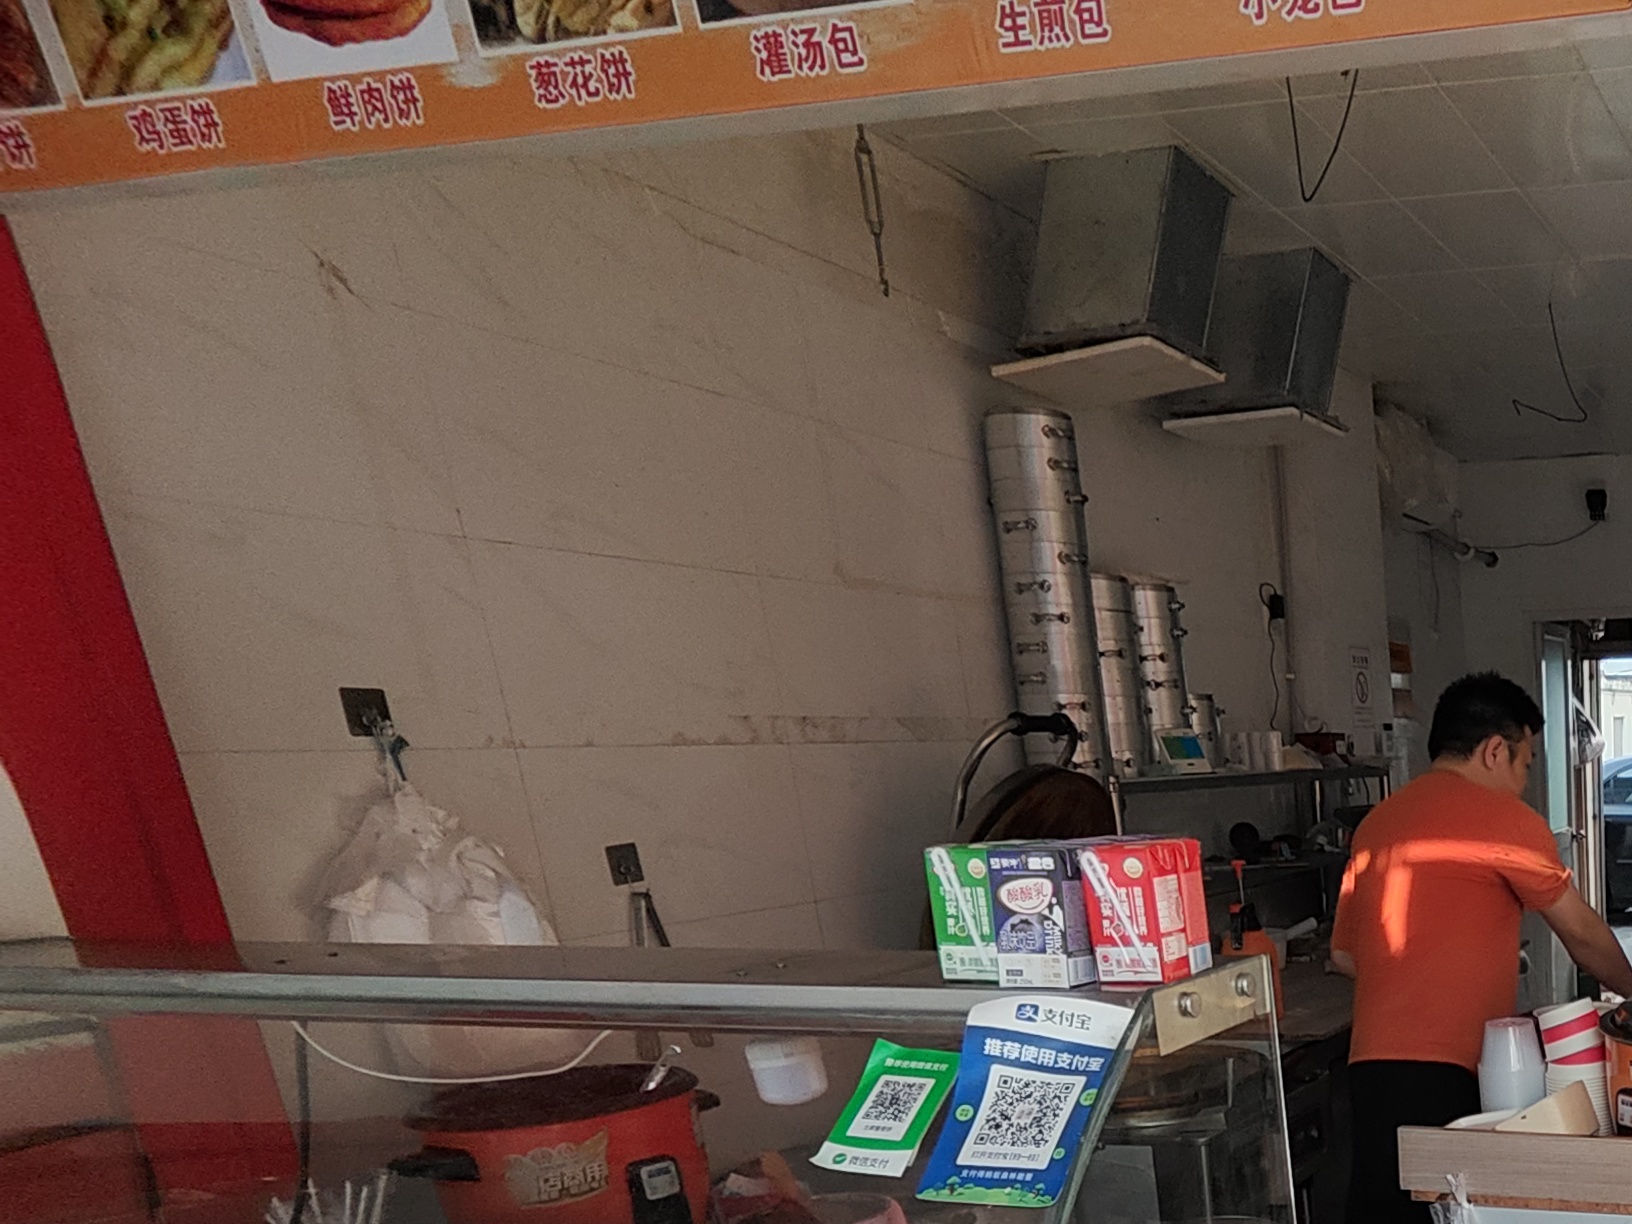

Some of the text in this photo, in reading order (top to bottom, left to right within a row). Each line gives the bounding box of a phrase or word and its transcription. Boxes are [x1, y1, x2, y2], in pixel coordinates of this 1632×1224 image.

[752, 21, 867, 80] 灌汤包
[998, 0, 1110, 51] 生煎包
[528, 46, 637, 108] 葱花饼
[127, 100, 225, 153] 鸡蛋饼
[322, 75, 426, 132] 鲜肉饼
[1006, 882, 1049, 902] 酸酸乳
[1040, 1008, 1092, 1031] 支付宝
[983, 1037, 1105, 1072] 推荐使用支付宝
[848, 1155, 889, 1169] 微信支付
